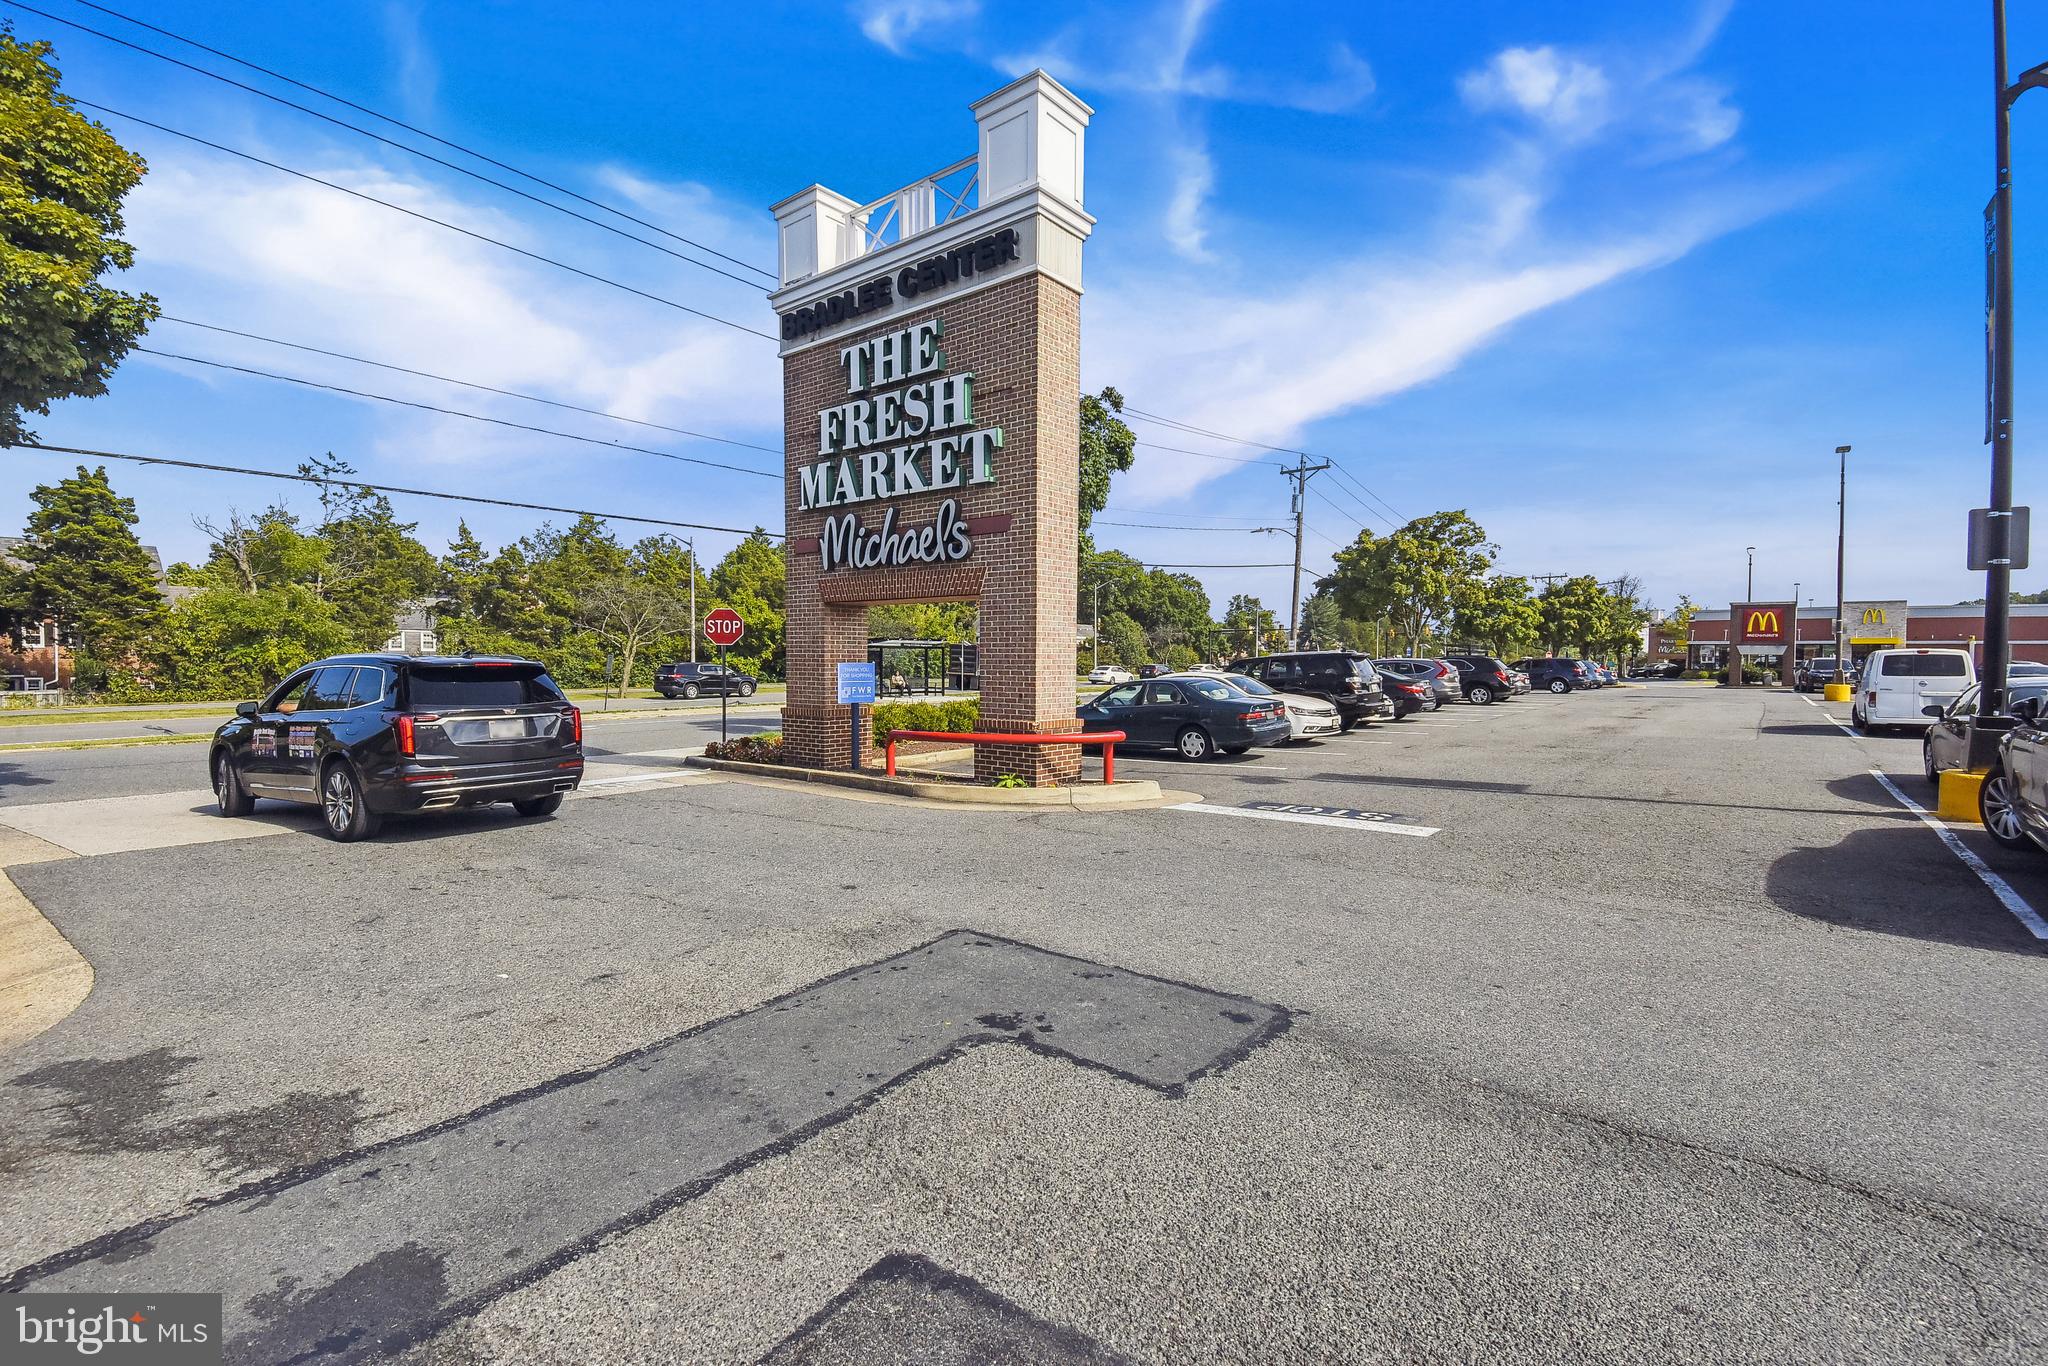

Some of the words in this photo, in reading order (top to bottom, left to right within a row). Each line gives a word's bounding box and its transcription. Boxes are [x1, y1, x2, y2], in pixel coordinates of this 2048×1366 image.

[782, 276, 893, 340] BRADLEE
[897, 228, 1020, 298] CENTER
[840, 318, 945, 394] THE
[818, 372, 975, 456] FRESH
[798, 426, 1003, 511] MARKET
[820, 499, 973, 571] Michaels
[707, 620, 741, 634] STOP
[1256, 804, 1393, 821] STOP
